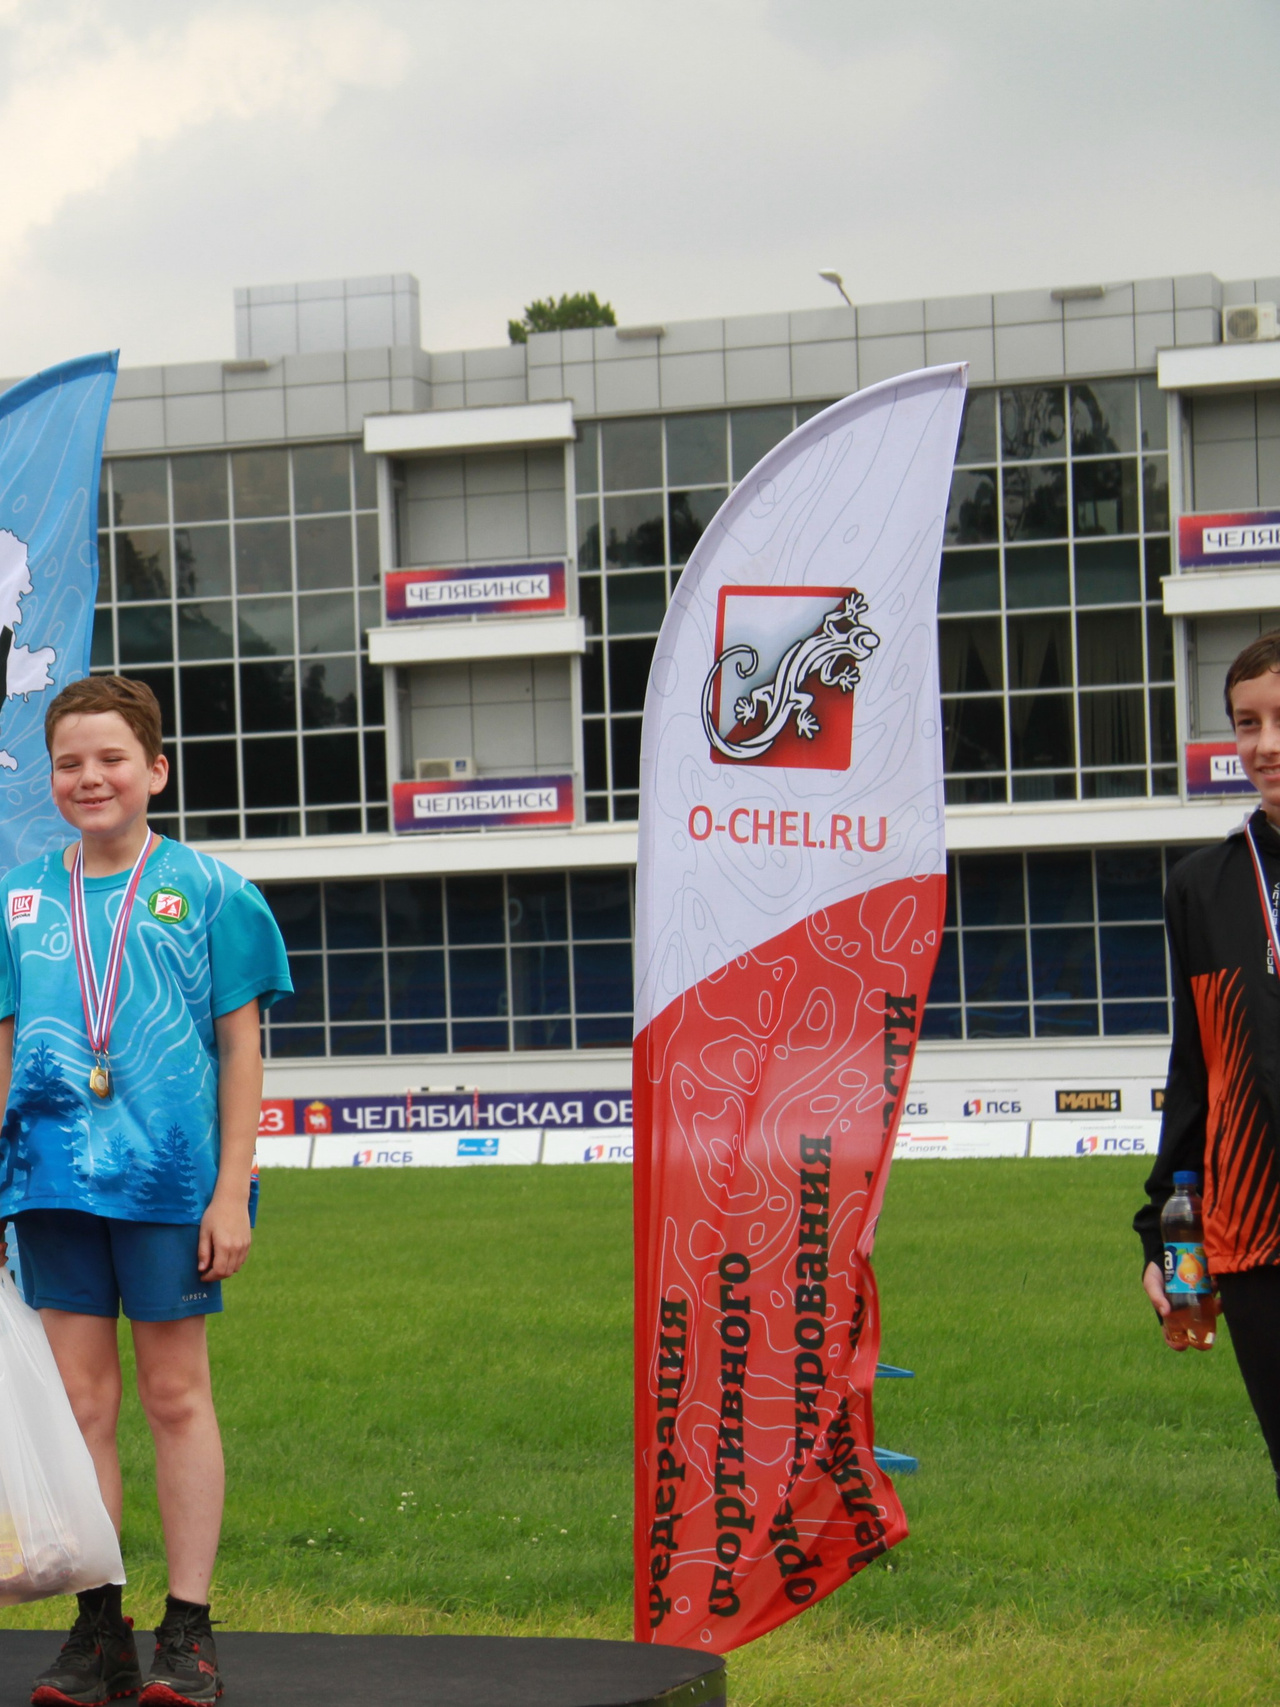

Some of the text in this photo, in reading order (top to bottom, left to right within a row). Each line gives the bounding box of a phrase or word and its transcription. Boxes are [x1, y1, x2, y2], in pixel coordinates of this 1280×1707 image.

[409, 578, 547, 602] ЧЕЛЯБИНСК
[416, 791, 554, 814] ЧЕЛЯБИНСК
[687, 805, 887, 852] O-CHEL.RU
[903, 1102, 929, 1116] СБ
[986, 1100, 1022, 1114] ПСБ
[1059, 1090, 1118, 1112] МАТЧ!
[342, 1101, 584, 1130] ЧЕЛЯБИНСКАЯ
[1102, 1137, 1146, 1151] ПСБ
[376, 1151, 414, 1164] ПСБ
[708, 1252, 756, 1618] спортивного
[649, 1296, 688, 1629] Федерация
